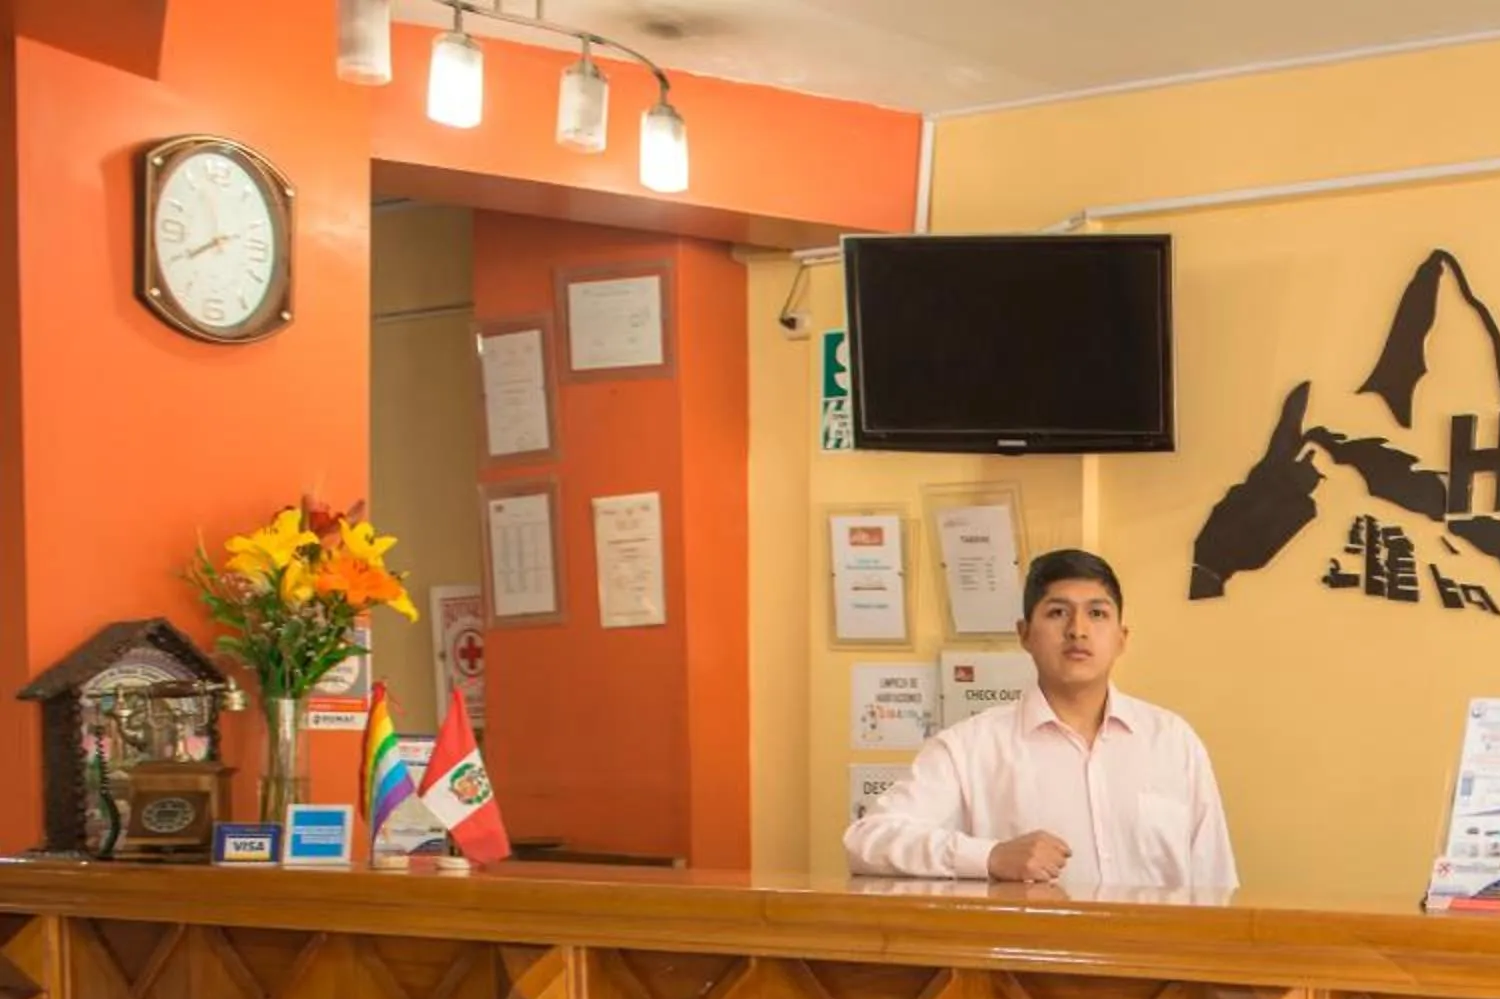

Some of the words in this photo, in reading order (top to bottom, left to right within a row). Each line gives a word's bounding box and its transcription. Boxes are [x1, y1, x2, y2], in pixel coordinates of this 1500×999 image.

[965, 689, 996, 701] CHECK
[999, 689, 1023, 701] OUT
[233, 840, 265, 852] VISA
